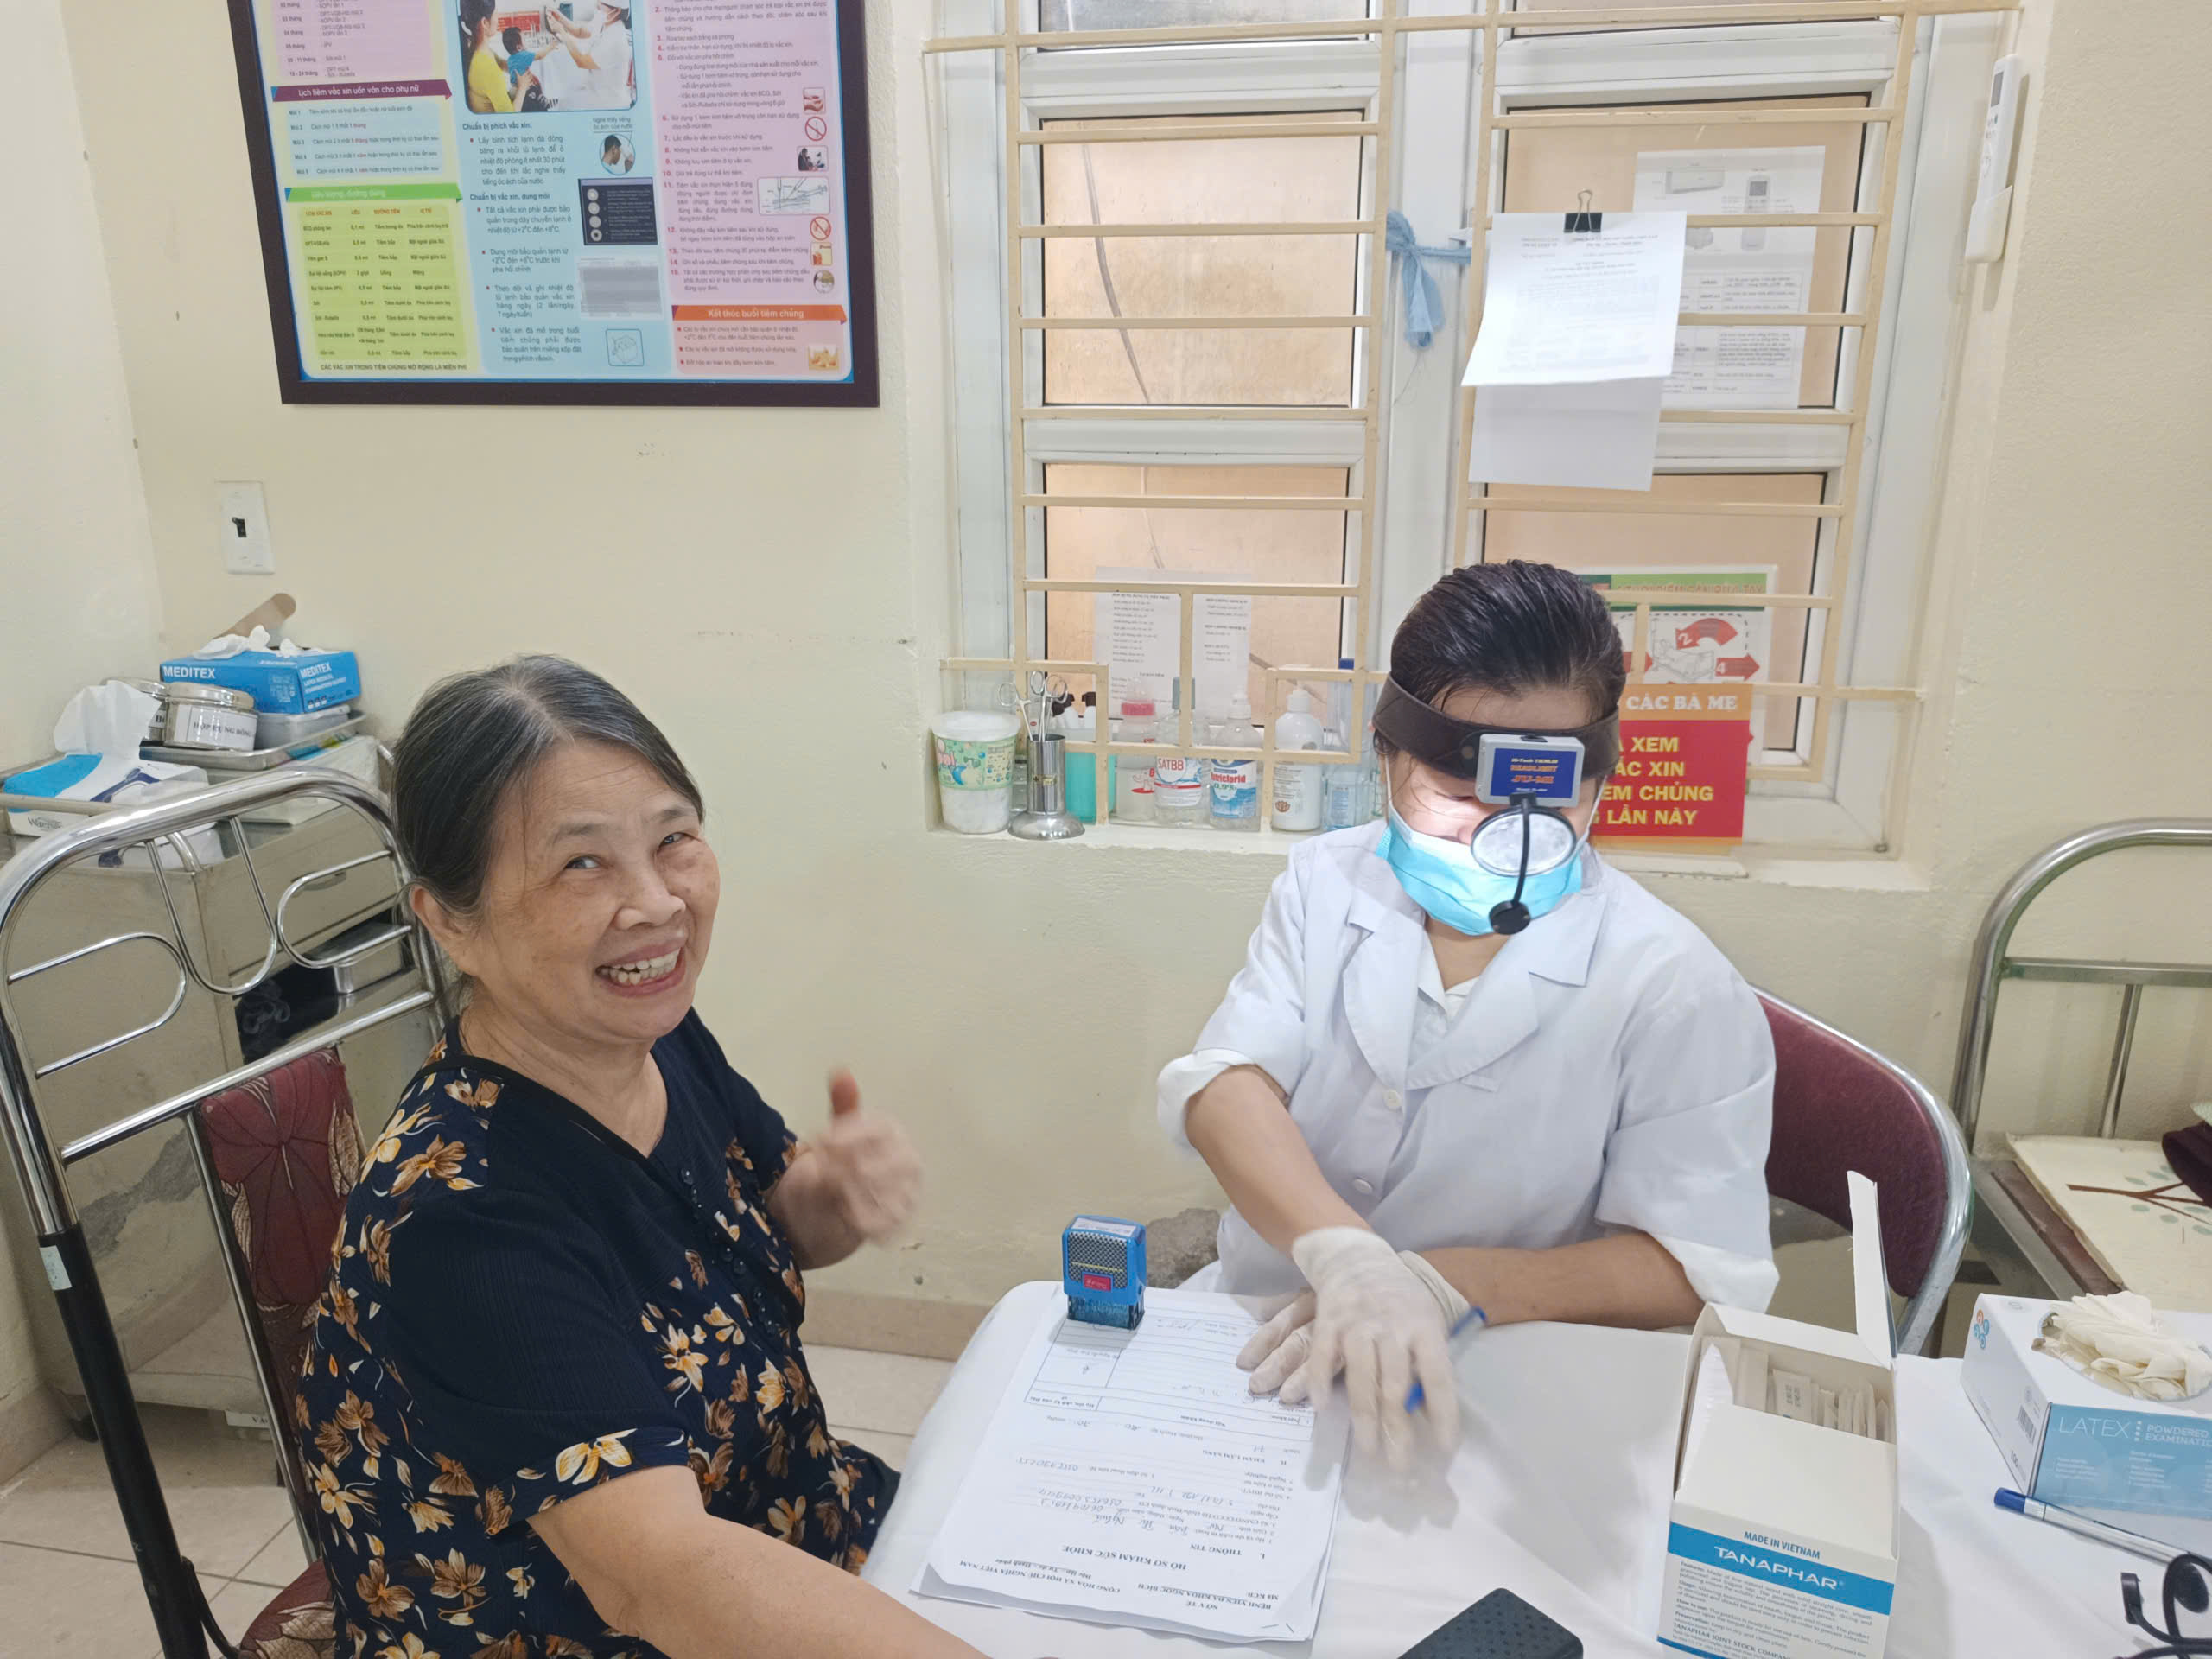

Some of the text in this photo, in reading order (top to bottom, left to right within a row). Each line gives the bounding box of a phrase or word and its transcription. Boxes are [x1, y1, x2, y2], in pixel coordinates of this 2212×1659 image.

[1678, 632, 1692, 645] 2
[162, 665, 215, 679] MEDITEX
[301, 662, 332, 677] MEDITEX
[1716, 662, 1726, 674] 4
[1626, 692, 1669, 710] CÁC
[1673, 692, 1702, 710] BÀ
[1630, 736, 1680, 752] XEM
[1158, 758, 1184, 771] SATBB
[1649, 761, 1685, 776] XIN
[1639, 781, 1714, 801] CHỦNG
[1607, 804, 1697, 825] LẦN NÀY
[2059, 1417, 2131, 1438] LATEX
[2146, 1424, 2209, 1438] POWDERED
[1744, 1531, 1820, 1559] MADE IN VIETNAM
[1714, 1546, 1838, 1590] TANAPHAR
